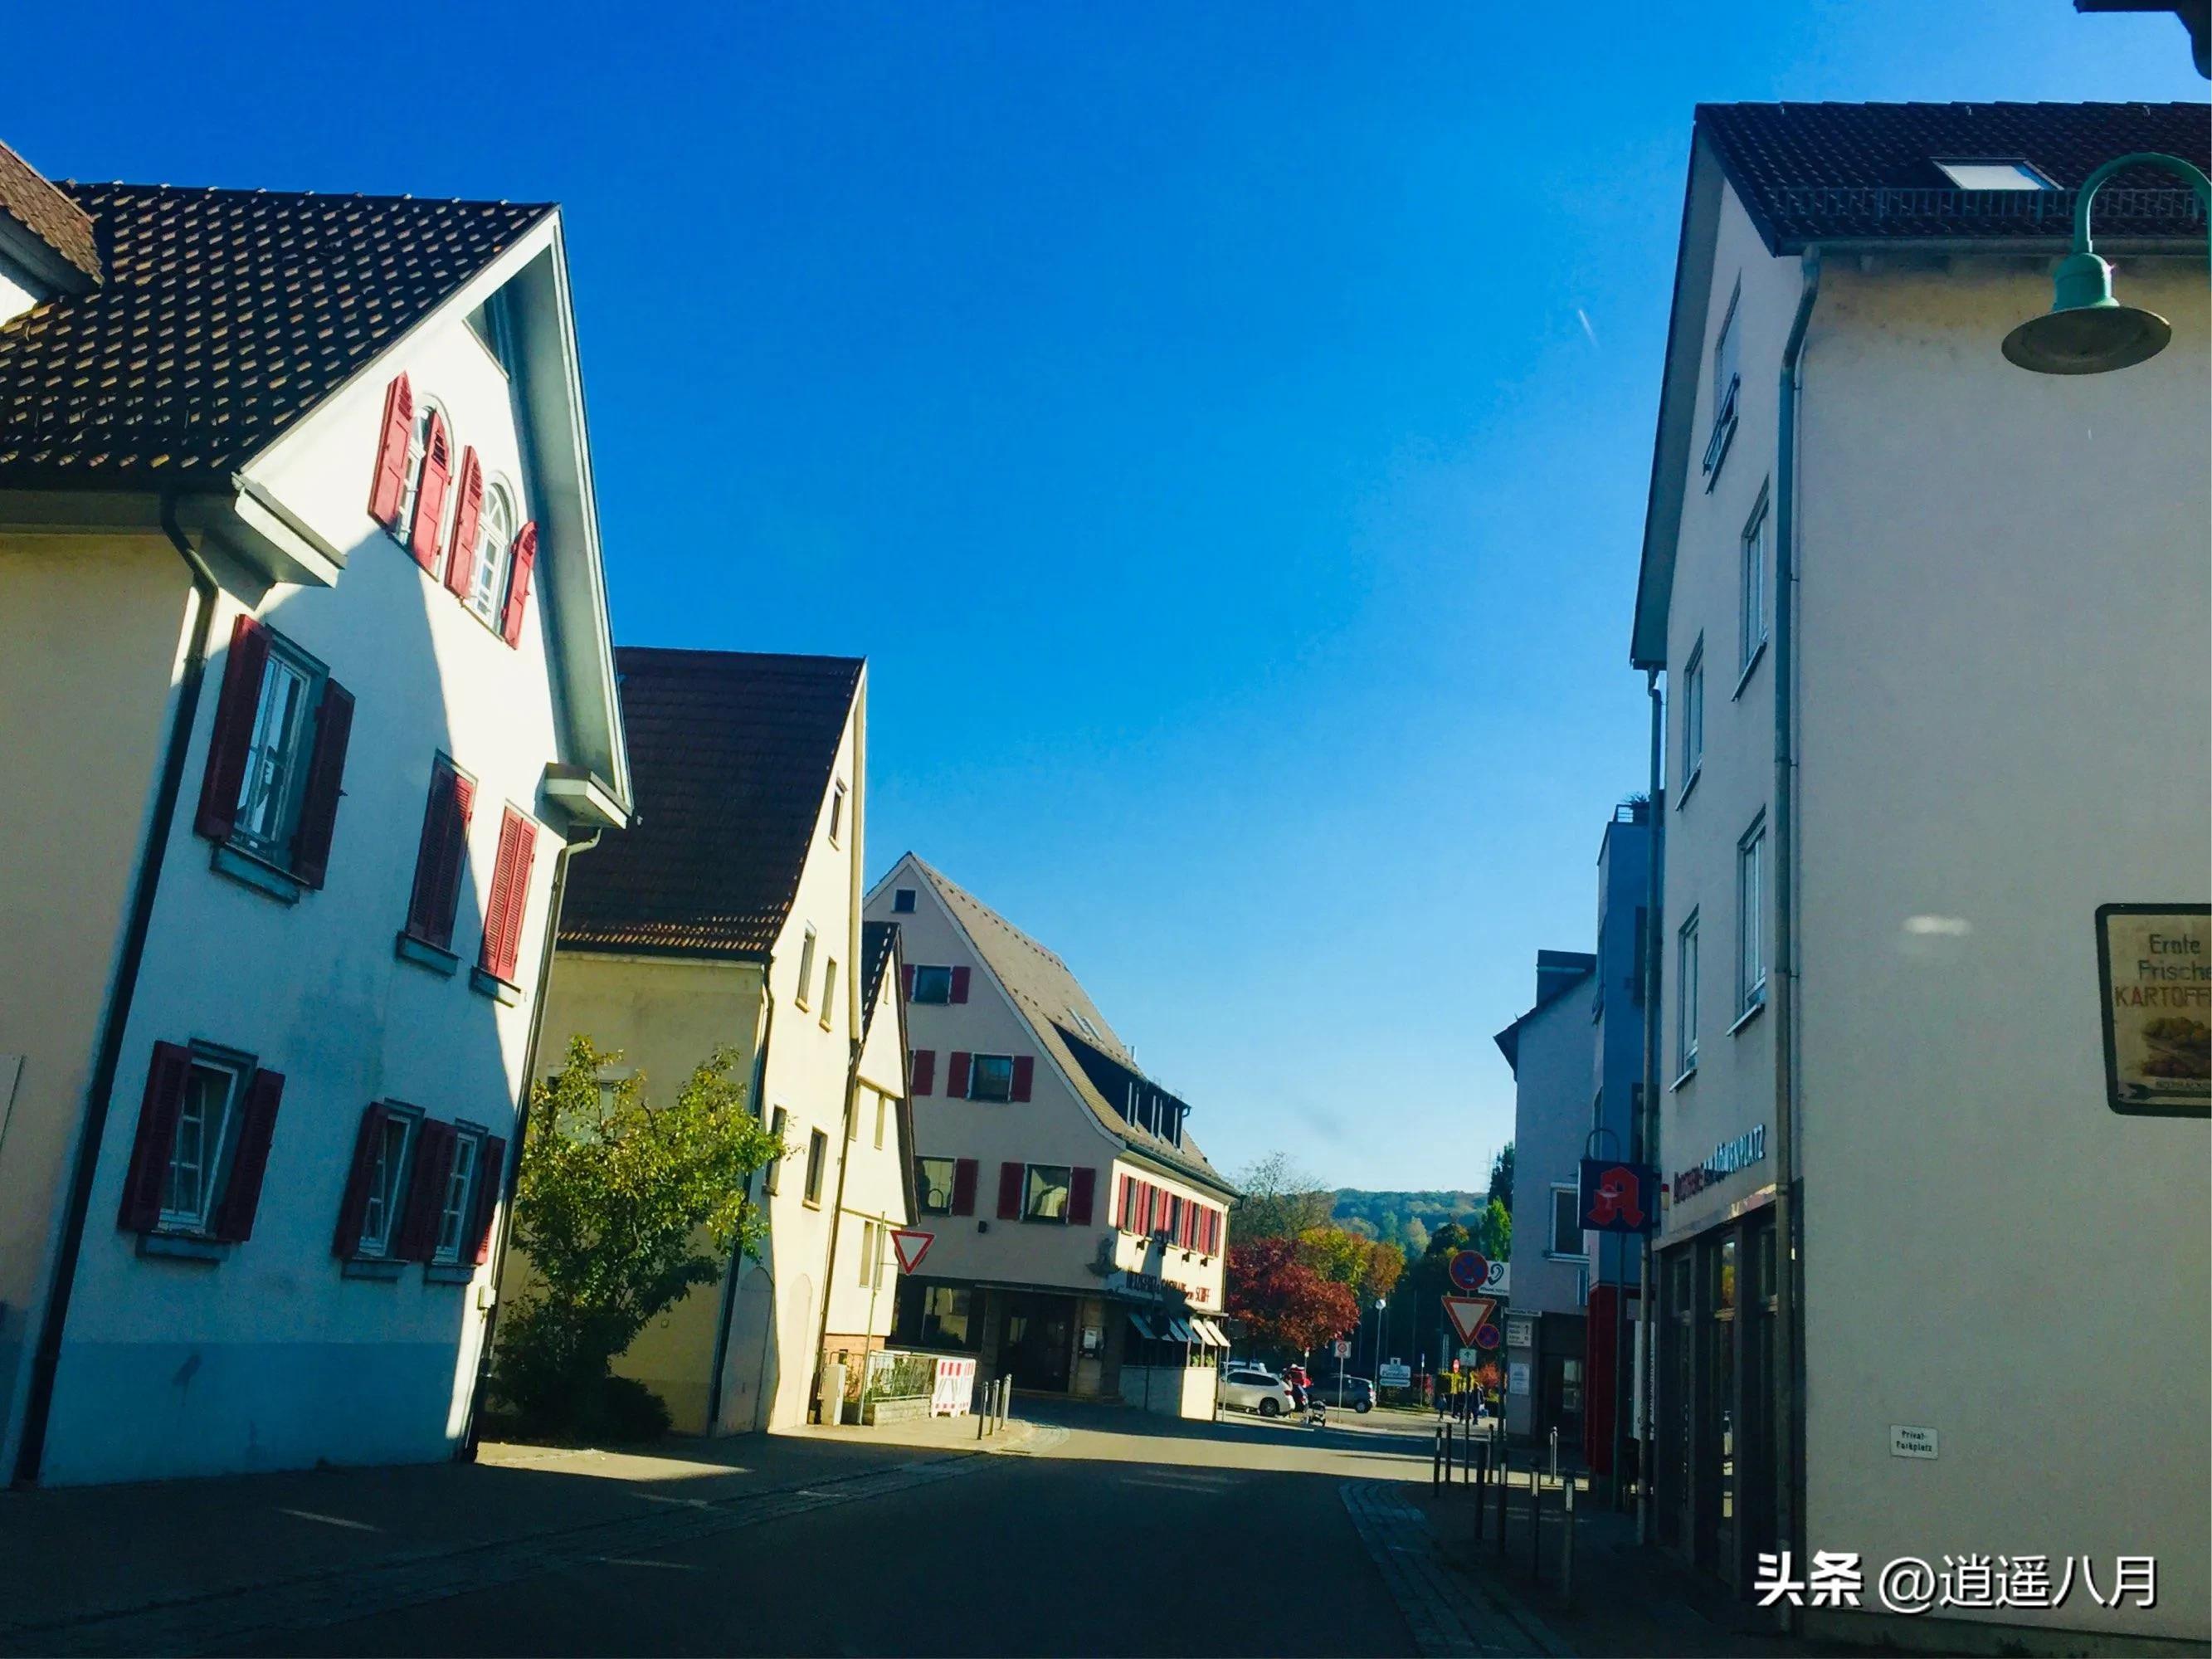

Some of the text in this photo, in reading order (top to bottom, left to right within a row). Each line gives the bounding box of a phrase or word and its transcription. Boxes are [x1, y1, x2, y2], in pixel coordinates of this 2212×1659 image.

[2149, 934, 2200, 954] Ernte
[2115, 986, 2211, 1008] KARTOFF
[1896, 1440, 1932, 1452] Parkplatz
